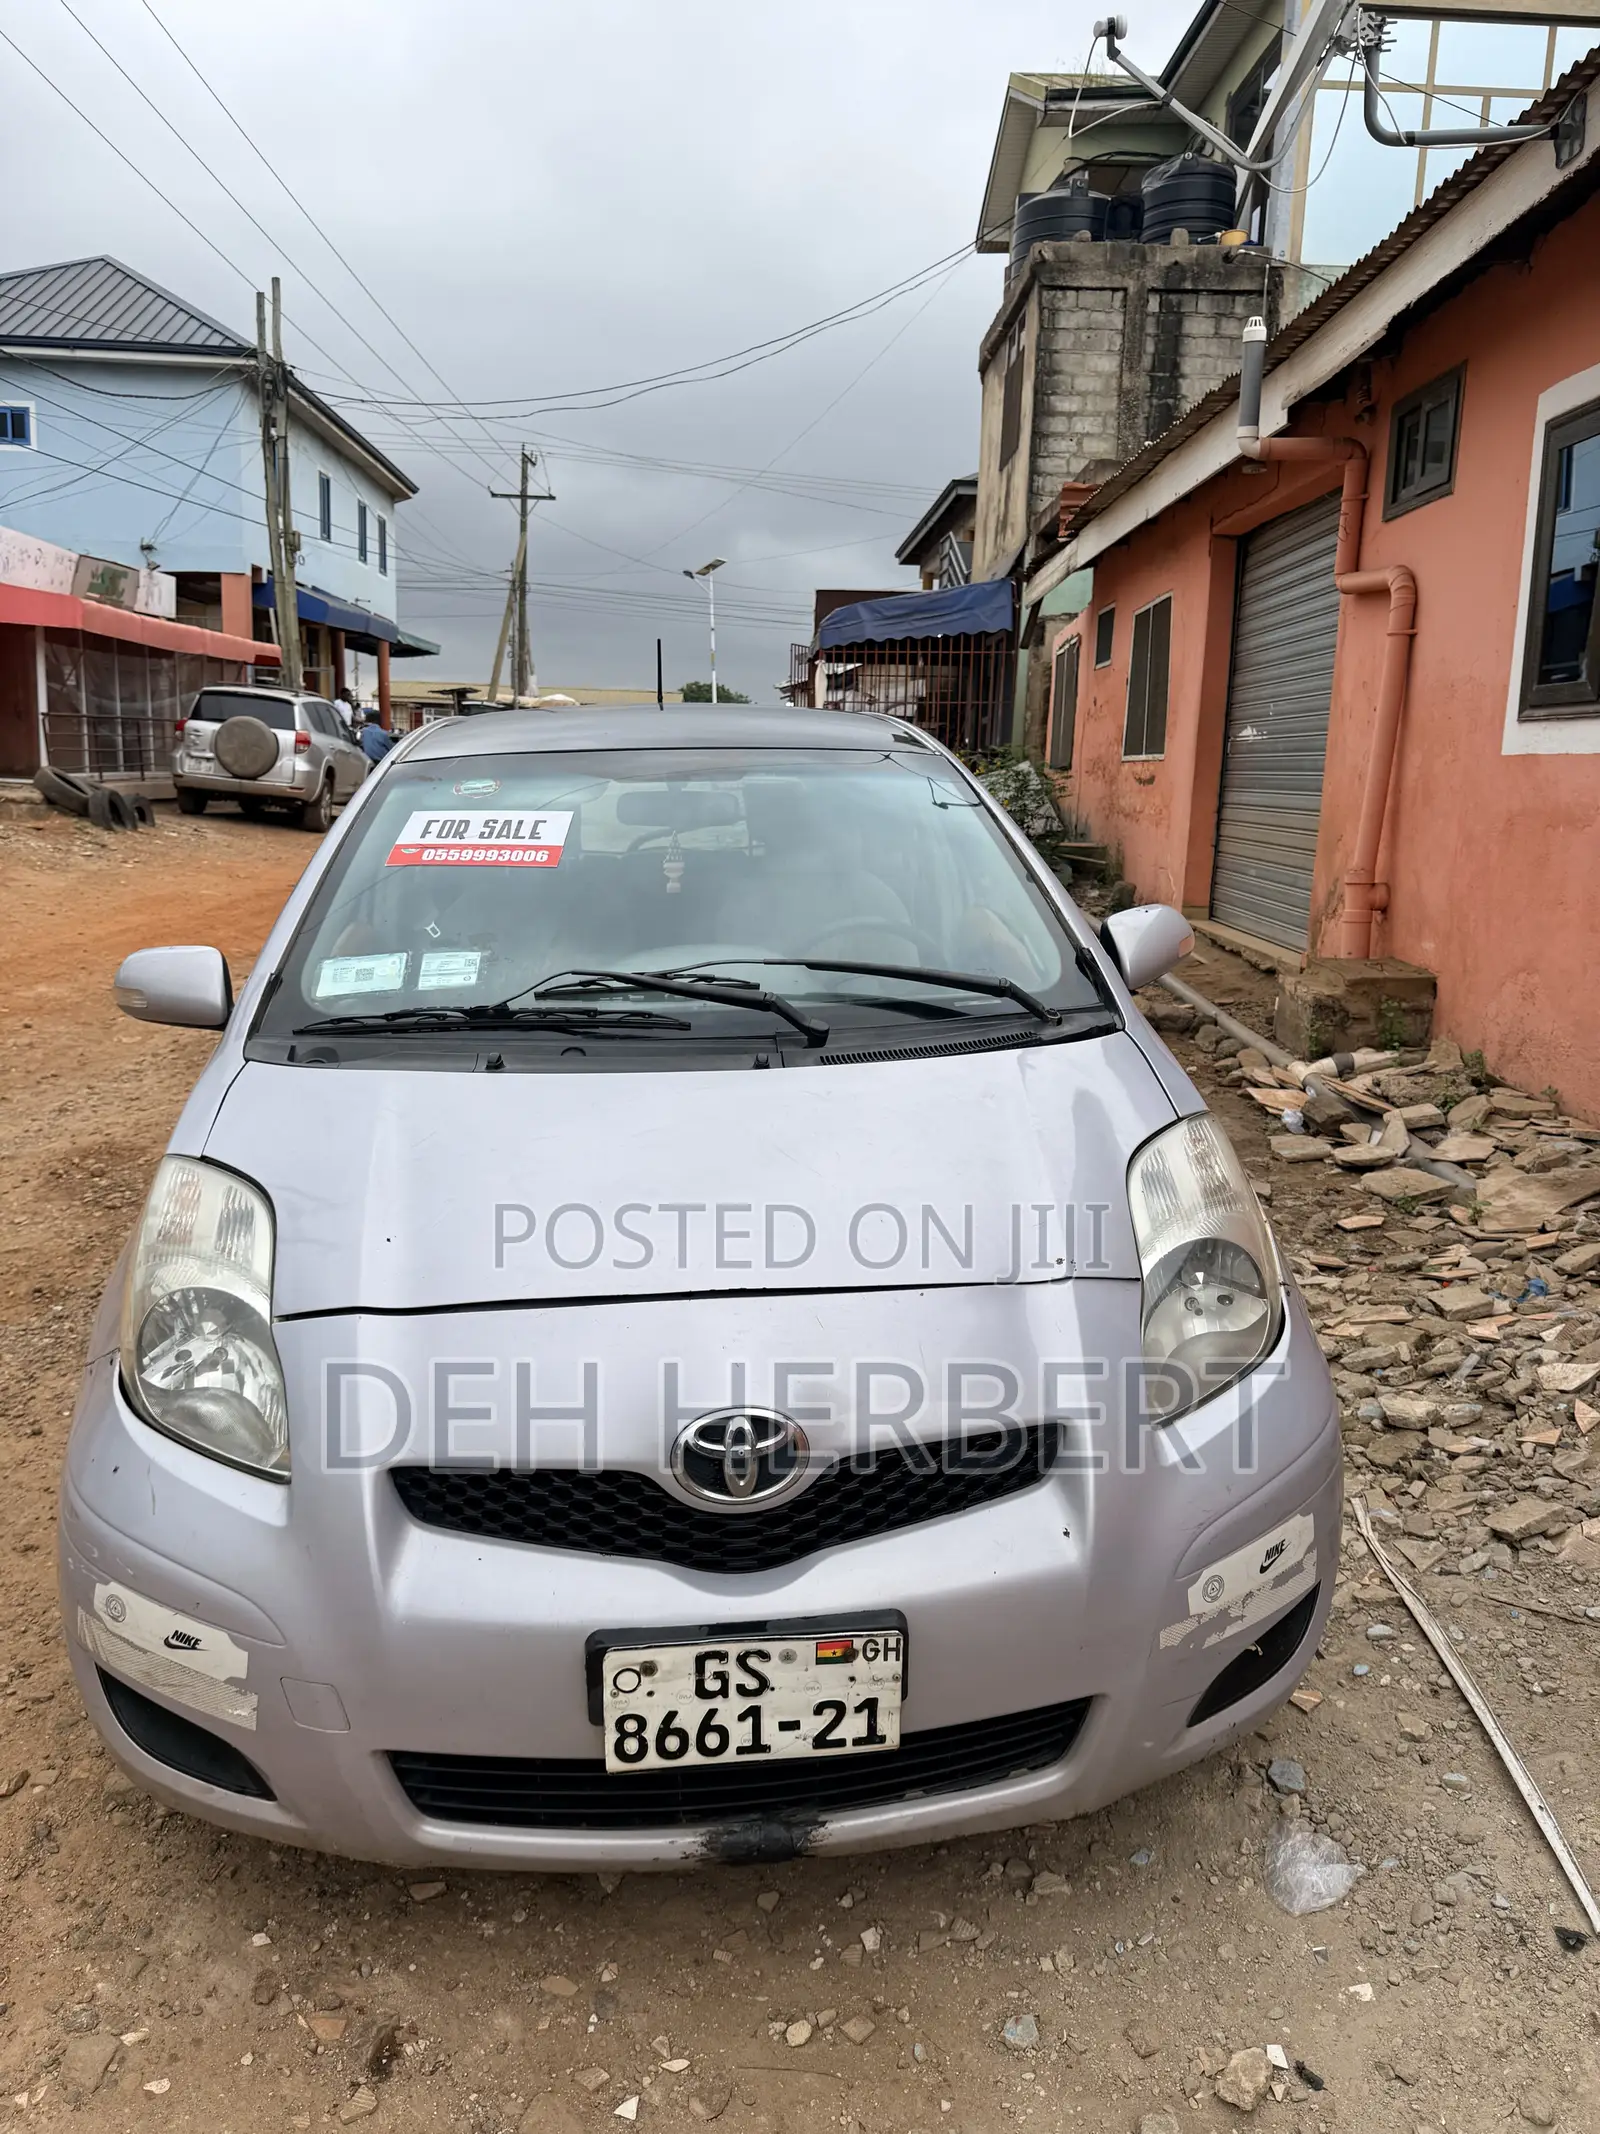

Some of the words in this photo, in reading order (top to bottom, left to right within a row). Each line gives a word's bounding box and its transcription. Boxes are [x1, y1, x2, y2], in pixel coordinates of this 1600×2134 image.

[420, 819, 470, 840] FOR
[478, 819, 547, 840] SALE
[421, 848, 550, 863] 0559993006
[1264, 1538, 1286, 1563] NIKE
[171, 1629, 202, 1649] NIKE
[694, 1650, 771, 1699] GS
[862, 1638, 901, 1662] GH
[614, 1697, 887, 1763] 8661-21
